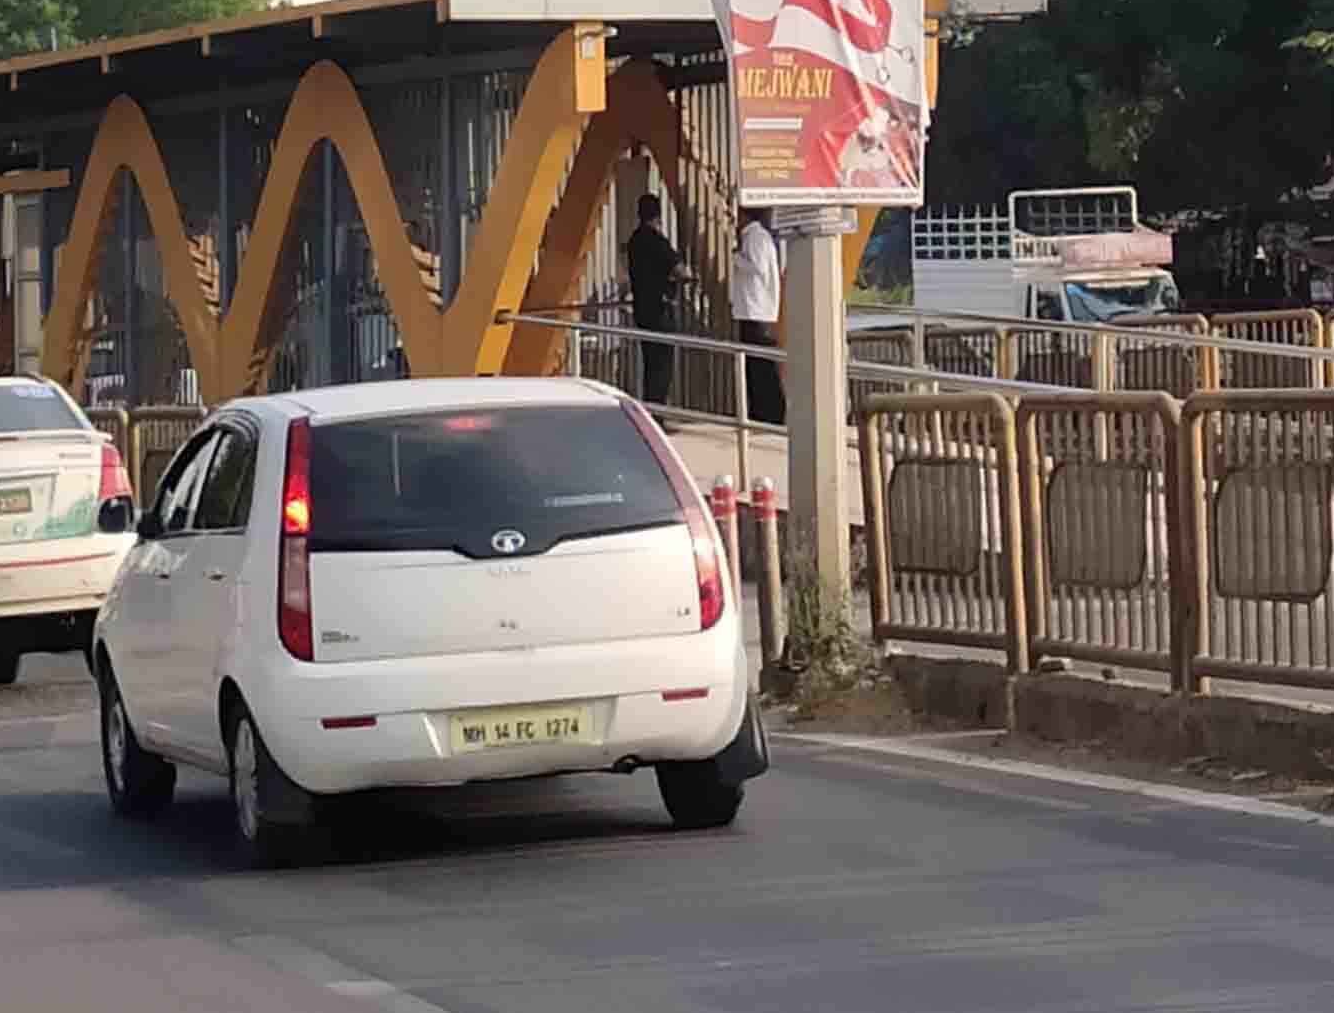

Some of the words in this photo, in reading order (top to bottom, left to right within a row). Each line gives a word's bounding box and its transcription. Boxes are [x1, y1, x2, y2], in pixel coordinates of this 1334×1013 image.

[737, 66, 833, 100] MEJWANI
[462, 723, 486, 742] MH
[494, 722, 510, 739] 14
[516, 720, 535, 739] FC
